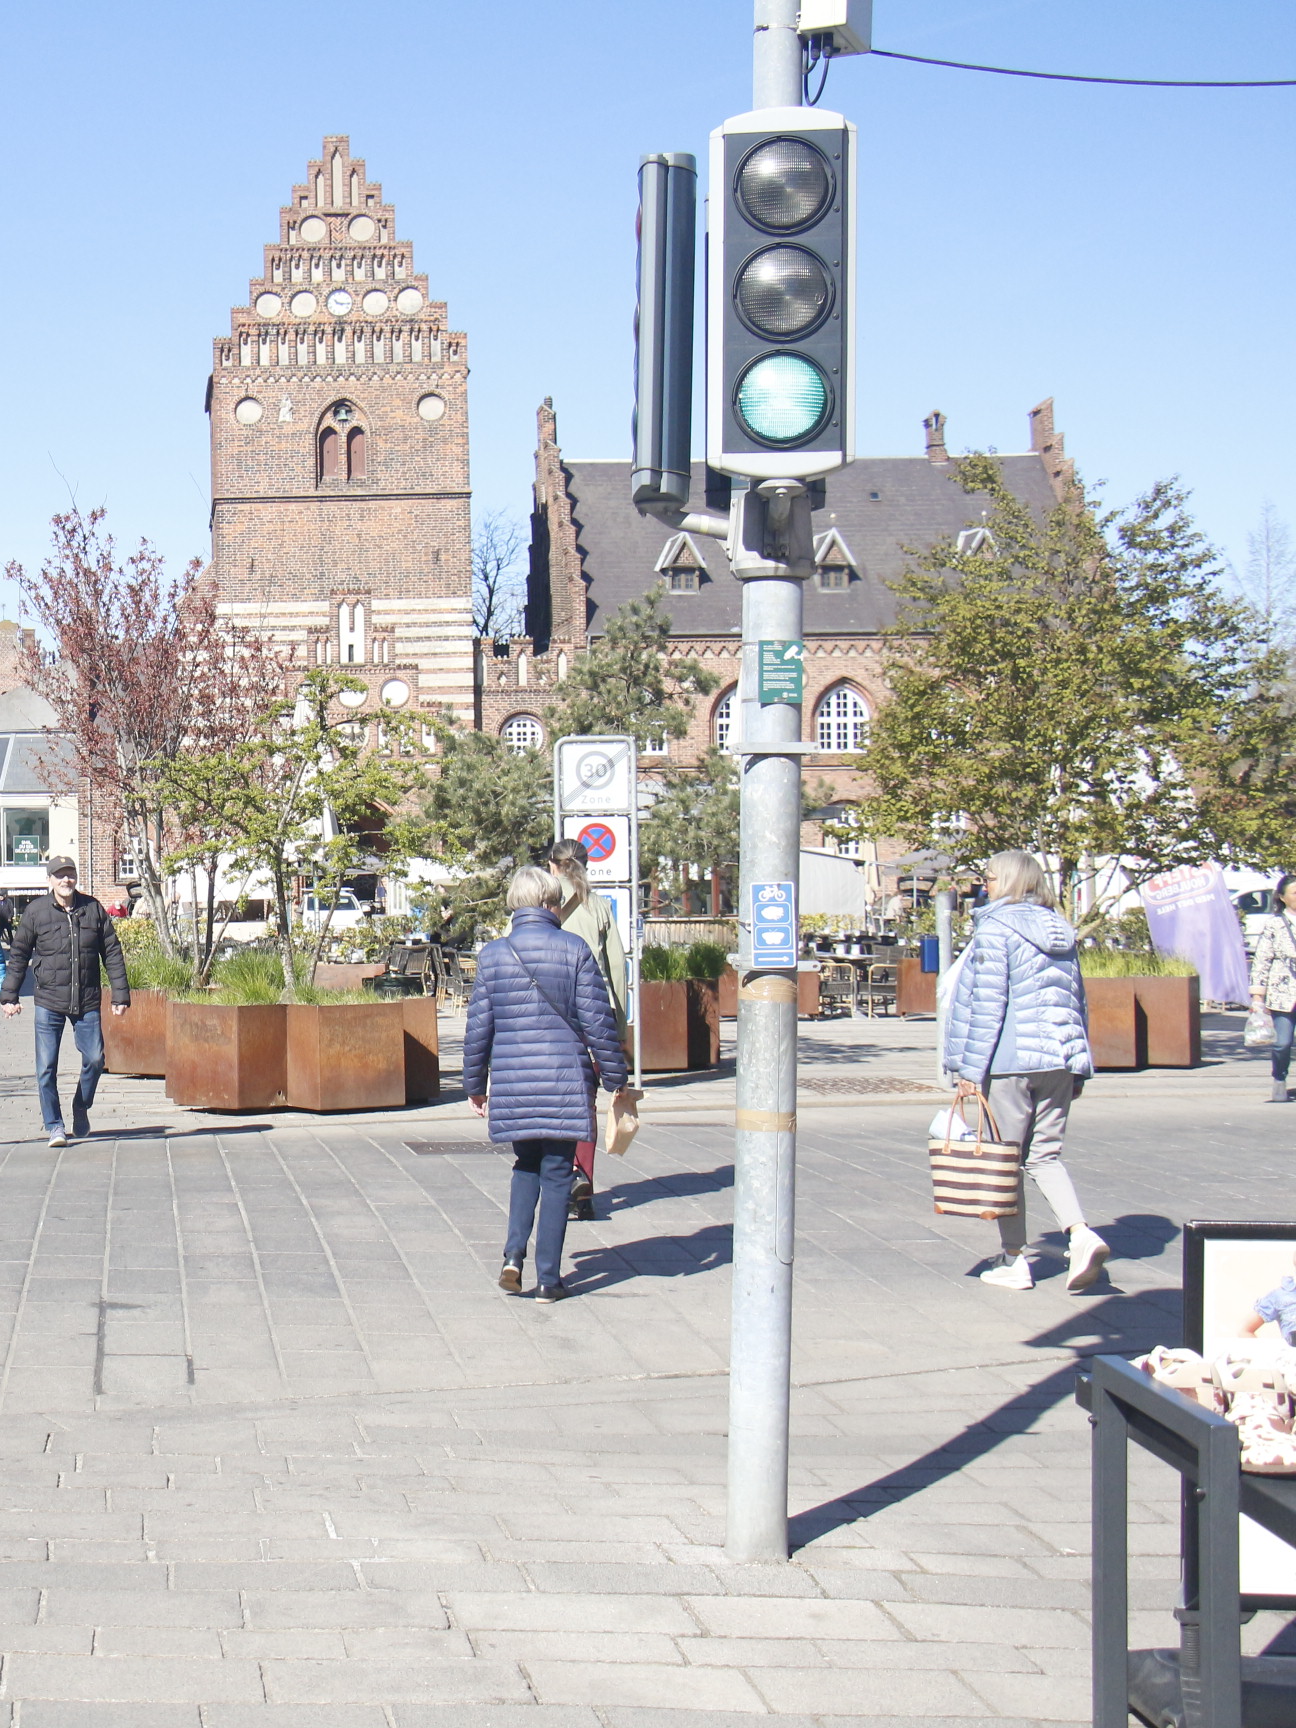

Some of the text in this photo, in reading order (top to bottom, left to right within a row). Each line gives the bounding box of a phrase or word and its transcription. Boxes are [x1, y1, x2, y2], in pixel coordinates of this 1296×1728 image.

[584, 763, 607, 778] 30
[581, 795, 611, 804] Zone
[589, 866, 612, 876] one
